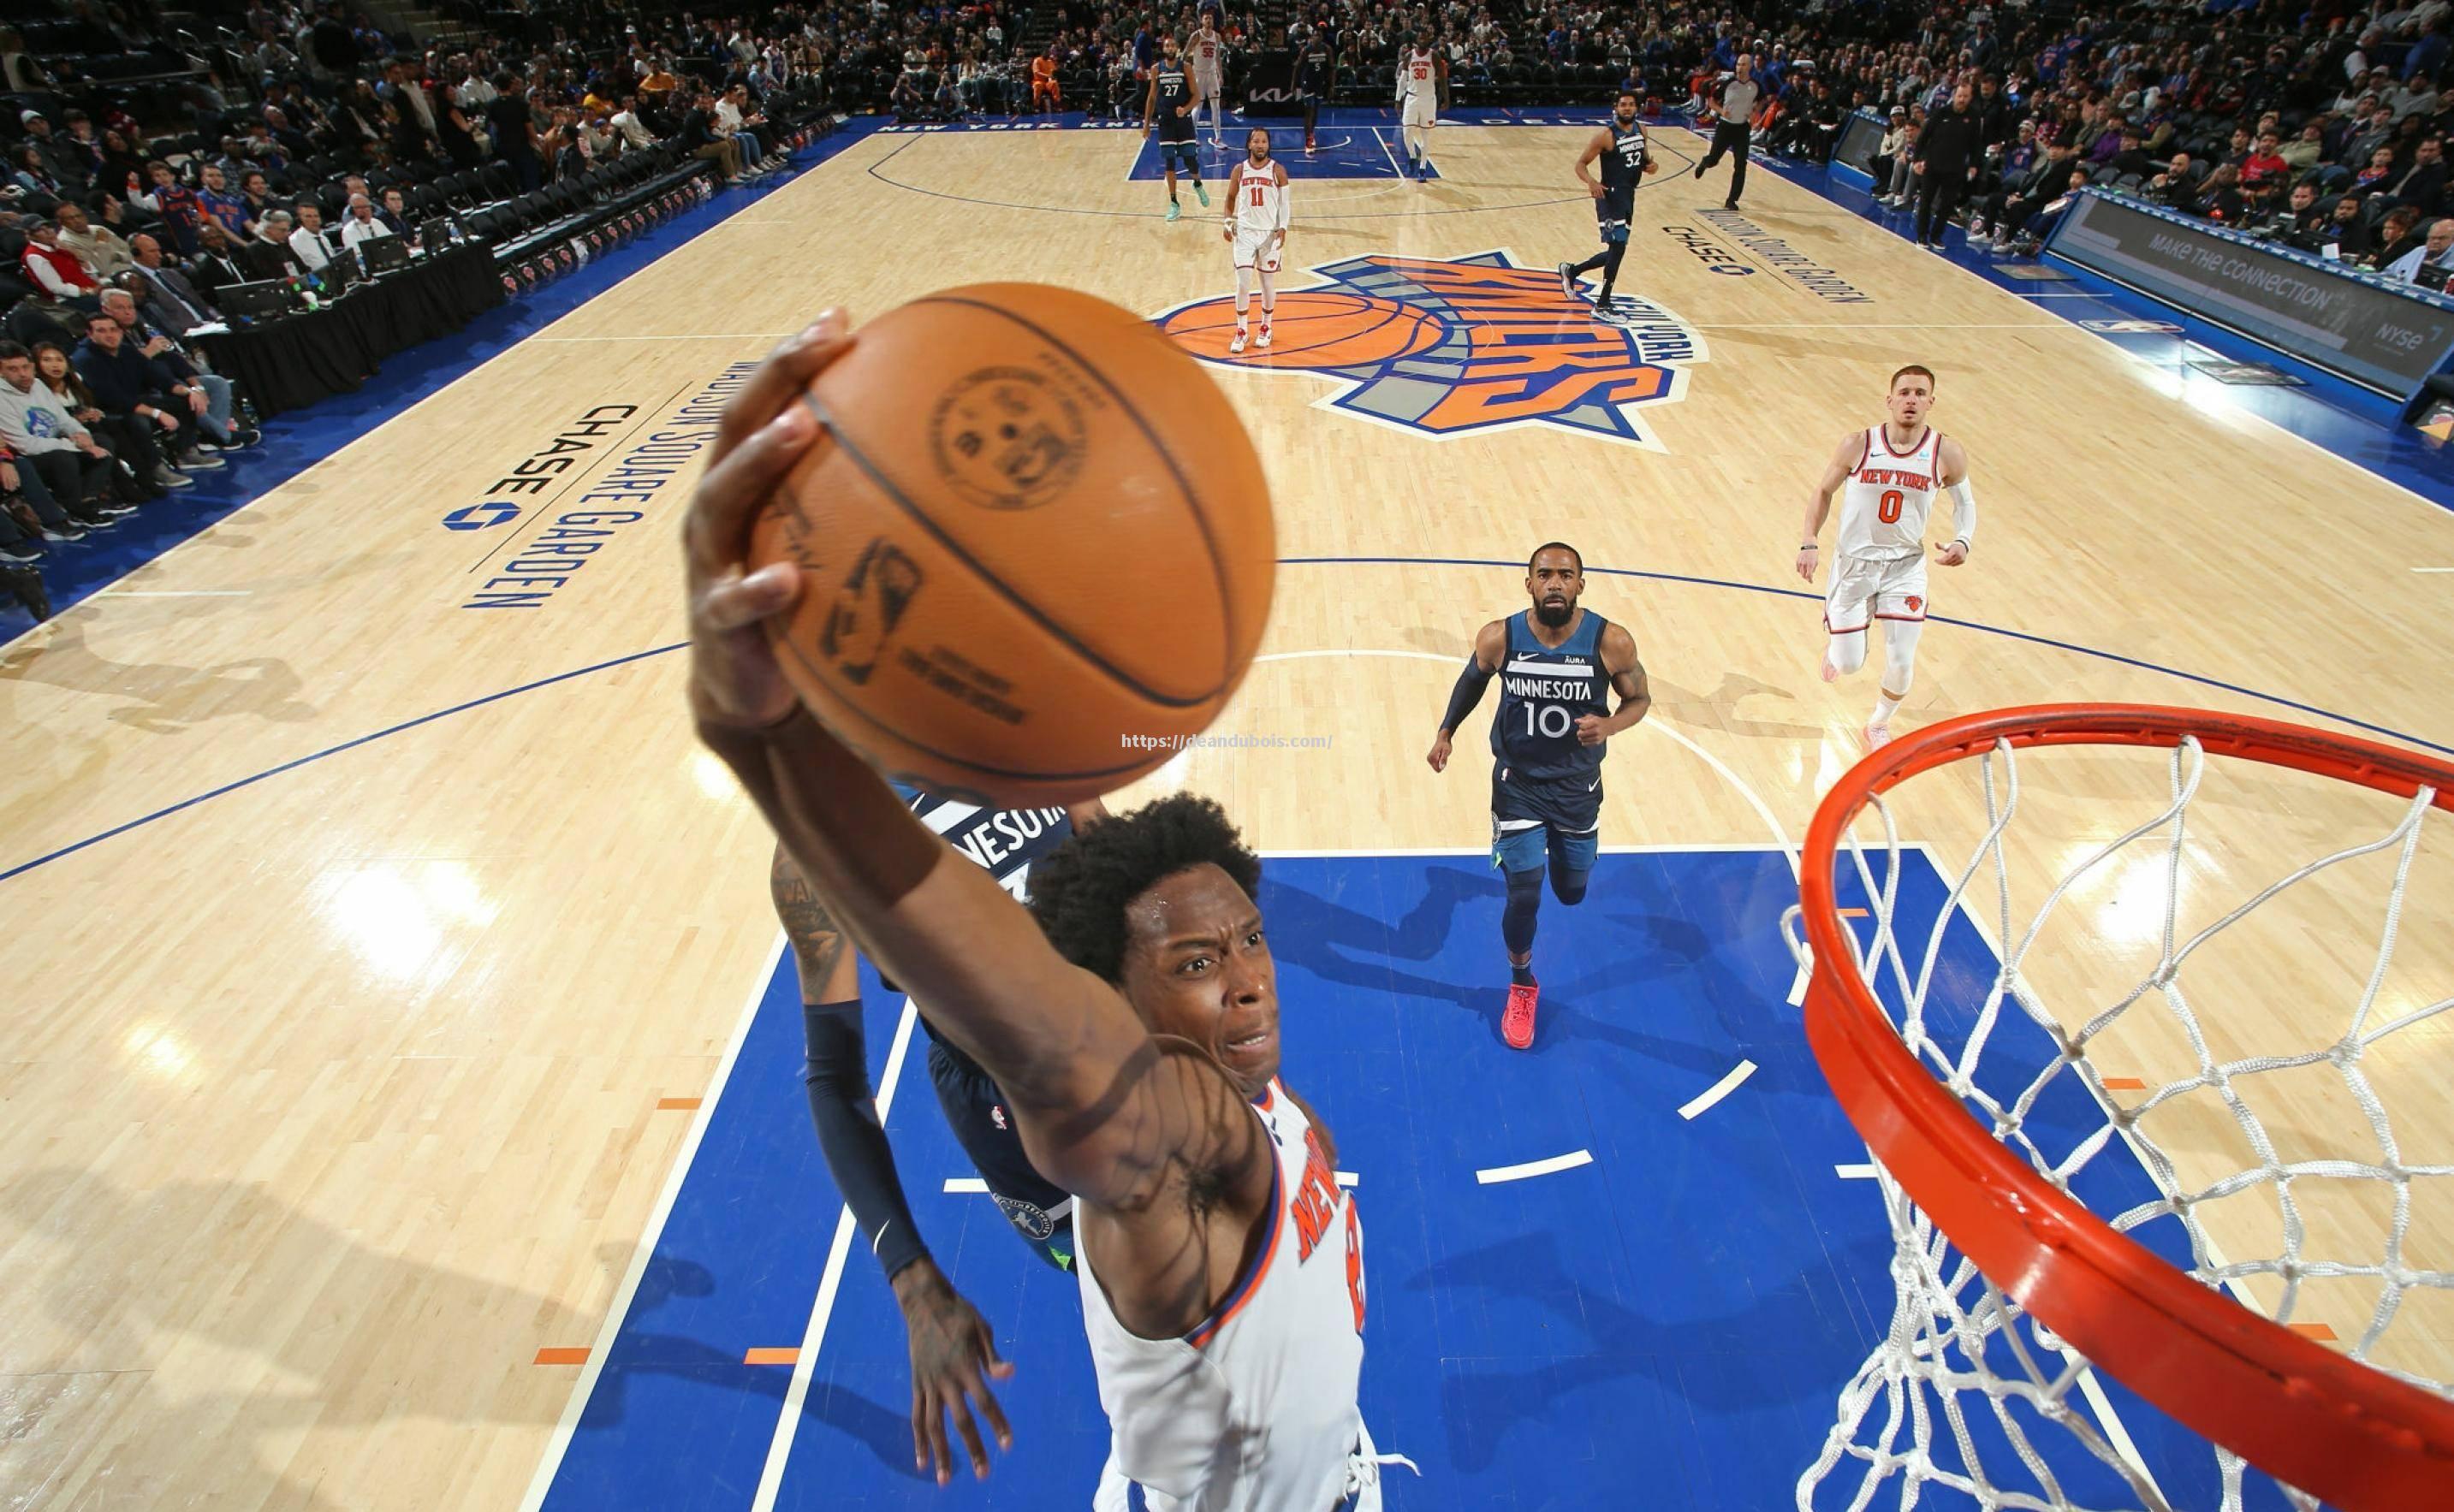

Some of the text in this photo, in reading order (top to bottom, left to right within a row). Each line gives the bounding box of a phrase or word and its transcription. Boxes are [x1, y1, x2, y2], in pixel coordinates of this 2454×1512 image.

[1315, 62, 1321, 71] 5
[1413, 68, 1427, 80] 30
[1164, 85, 1179, 97] 27
[1625, 151, 1642, 169] 32
[1251, 187, 1263, 206] 11
[1662, 226, 1738, 264] CHASE
[1784, 269, 1876, 304] GARDEN
[1631, 324, 1694, 362] YORK
[484, 404, 639, 495] CHASE
[579, 431, 720, 504] SQUARE
[1860, 469, 1933, 493] NEW YORK
[1878, 489, 1904, 524] 0
[460, 511, 645, 609] GARDEN
[1505, 677, 1592, 701] MINNESOTA
[1524, 701, 1571, 738] 10
